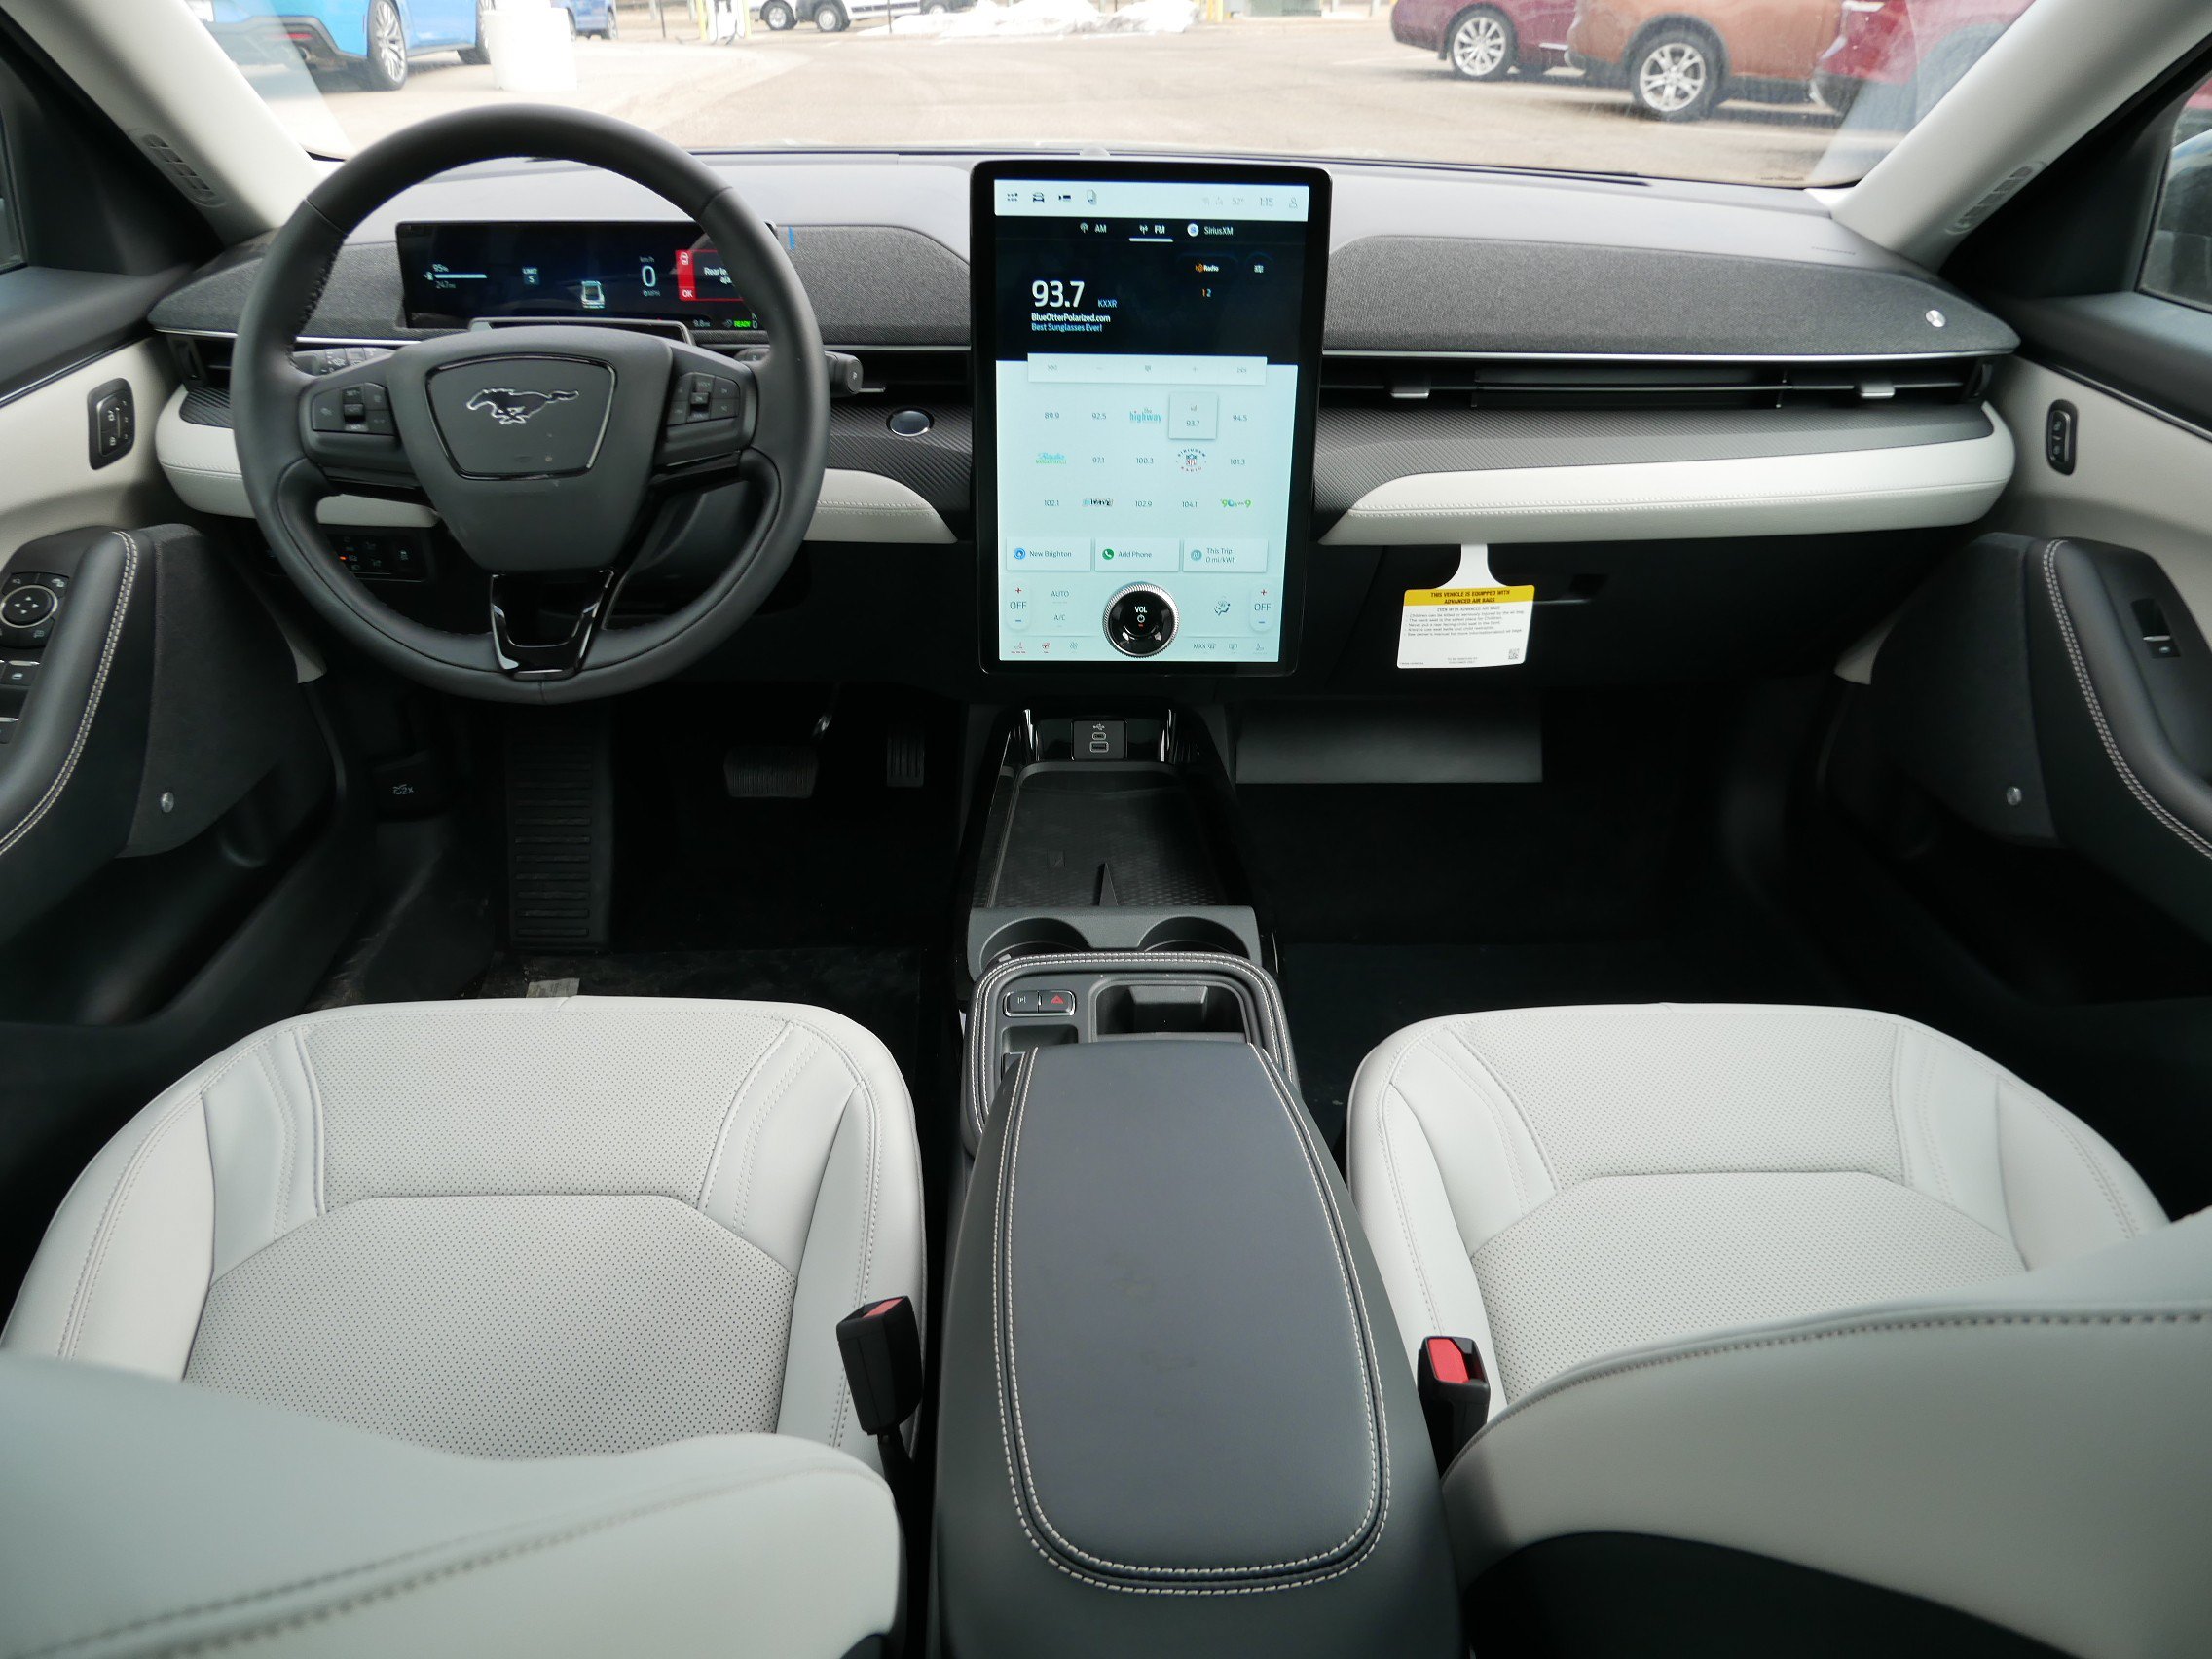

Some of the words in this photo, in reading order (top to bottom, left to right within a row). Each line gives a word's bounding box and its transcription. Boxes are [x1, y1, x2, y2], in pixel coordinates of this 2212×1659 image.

[1094, 224, 1107, 234] AM
[1154, 225, 1165, 234] FM
[1203, 226, 1234, 236] SiriusXM
[642, 265, 656, 287] 0
[704, 267, 719, 276] Rear
[1032, 279, 1086, 308] 93.7
[1097, 299, 1118, 308] KXXR
[1031, 313, 1111, 323] BlueOtterPolarized.com
[1048, 323, 1085, 333] Sunglasses
[1086, 323, 1103, 332] Ever!
[1129, 410, 1162, 423] highway
[1136, 457, 1154, 465] 100.3
[1230, 458, 1246, 466] 101.3
[1135, 499, 1153, 508] 102.9
[1044, 550, 1072, 560] Brighton
[1220, 548, 1233, 557] Trip
[1010, 601, 1027, 610] OFF
[1254, 603, 1272, 612] OFF
